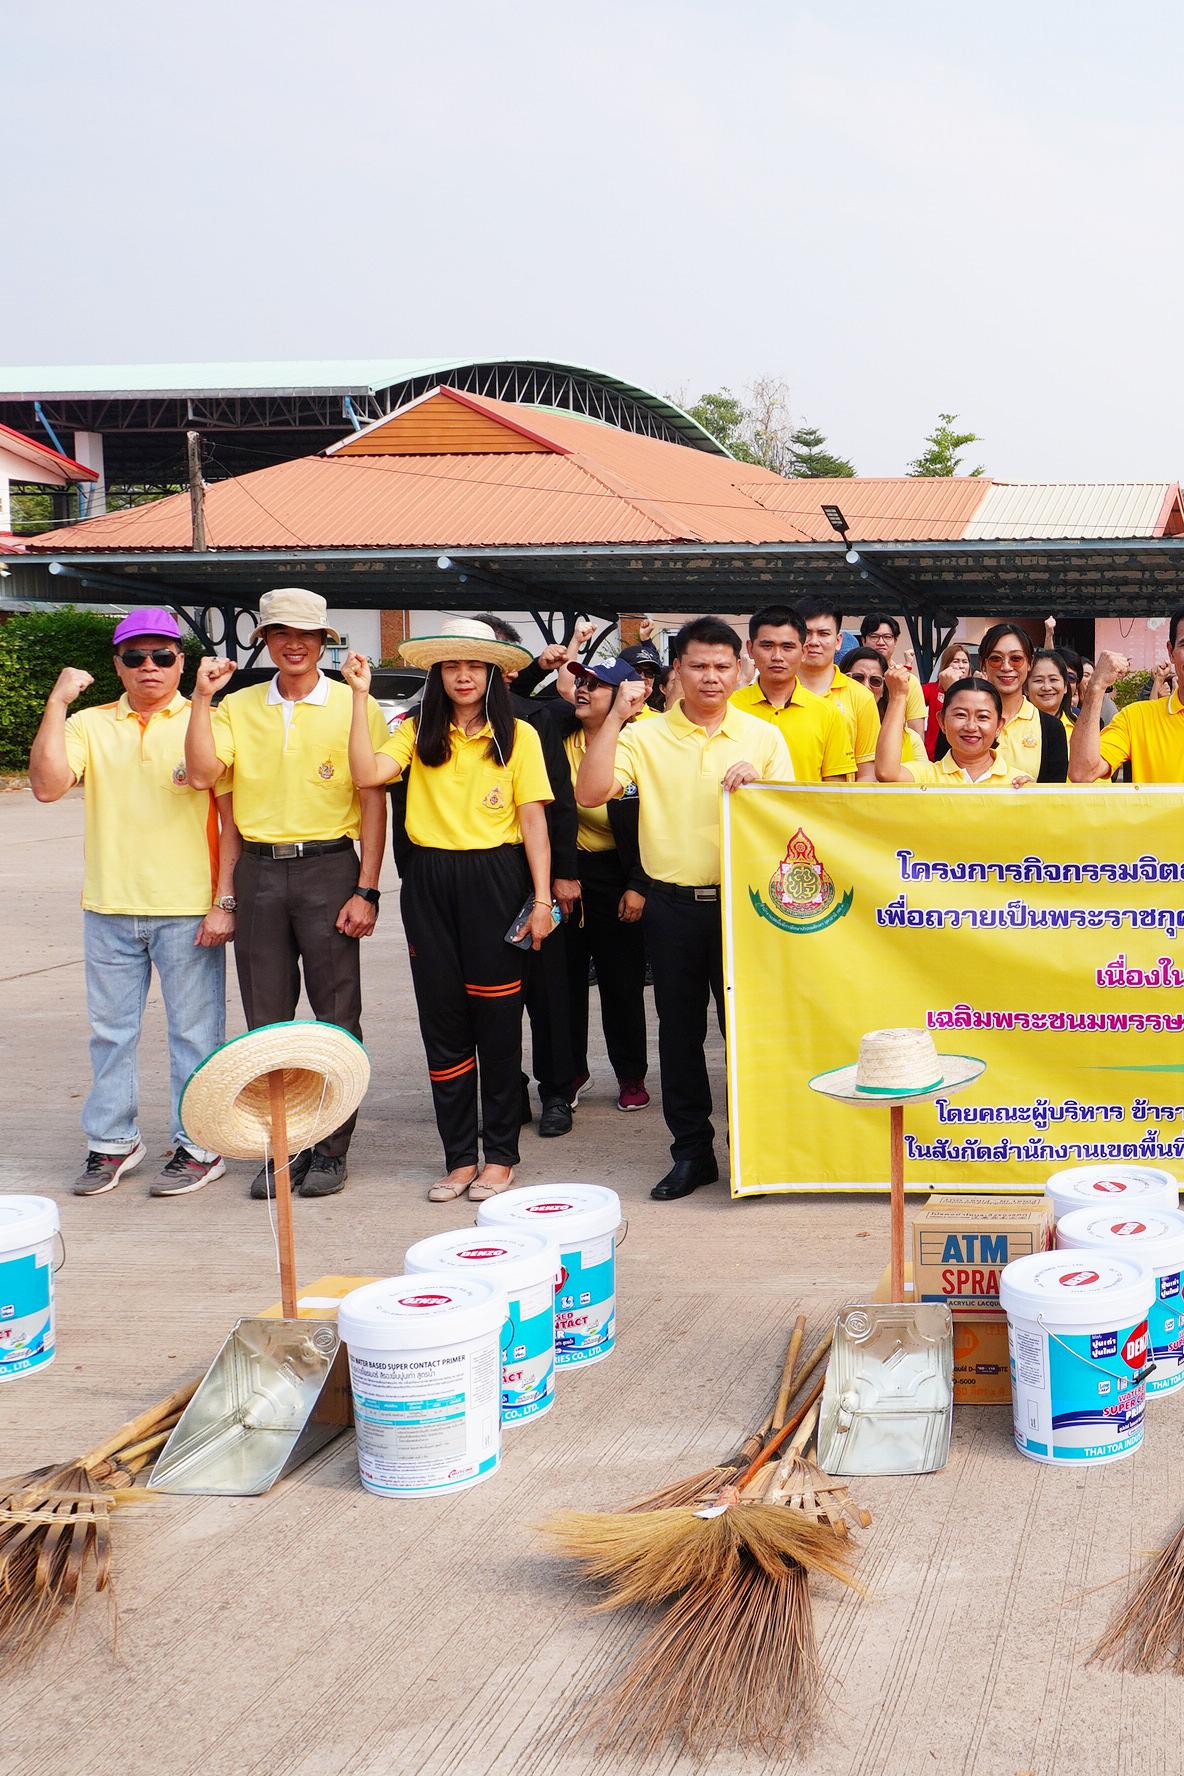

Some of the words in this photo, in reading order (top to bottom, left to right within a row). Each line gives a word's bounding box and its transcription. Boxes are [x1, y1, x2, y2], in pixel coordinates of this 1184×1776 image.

[935, 1099, 1124, 1130] โดยคณะผู้บริหาร
[941, 1235, 1008, 1263] ATM
[942, 1269, 1002, 1295] SPRA
[1092, 1339, 1116, 1348] ปูนเก่า
[1092, 1346, 1116, 1358] ปูนใหม่
[369, 1362, 386, 1370] BASED
[410, 1359, 440, 1369] CONTACT
[442, 1354, 465, 1366] PRIMER
[1103, 1400, 1136, 1417] SUPER
[1084, 1447, 1106, 1457] THAI
[1108, 1442, 1123, 1452] TOA
